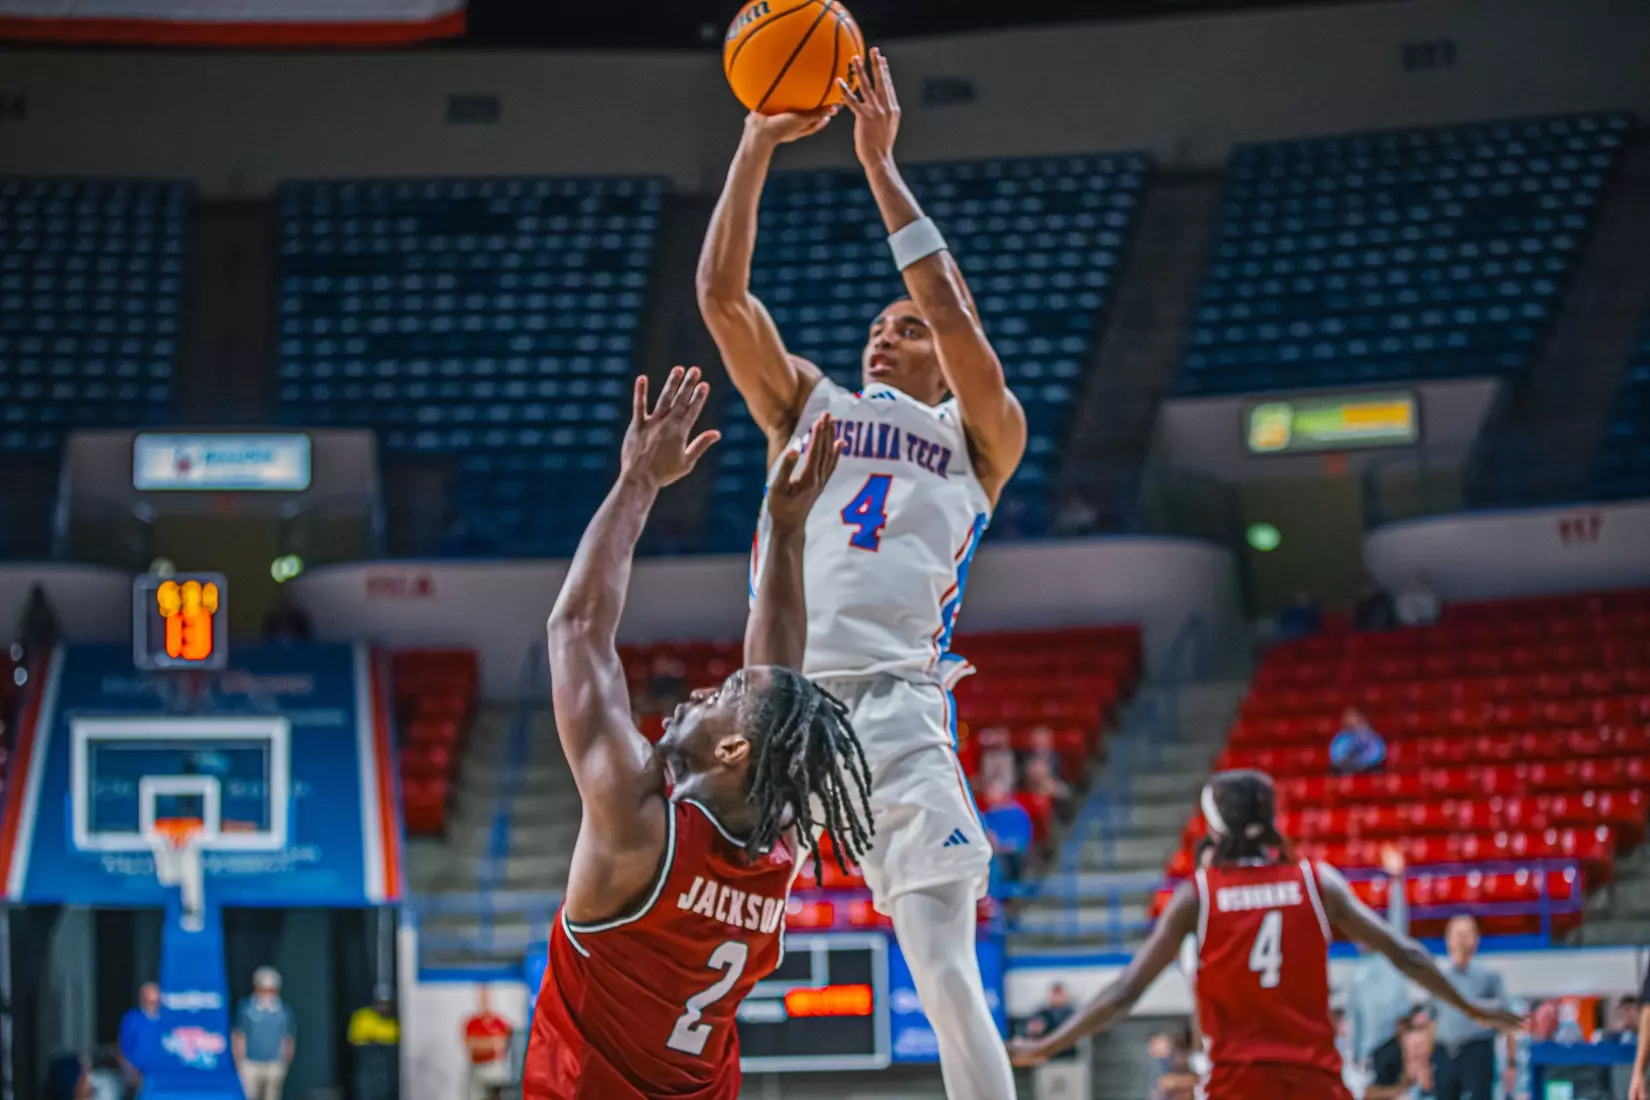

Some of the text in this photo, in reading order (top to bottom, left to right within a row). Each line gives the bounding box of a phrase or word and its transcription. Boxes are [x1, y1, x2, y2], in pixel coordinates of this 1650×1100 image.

[801, 419, 901, 460] ISIANA
[840, 473, 893, 552] 4
[1249, 910, 1283, 989] 4
[667, 941, 748, 1055] 2
